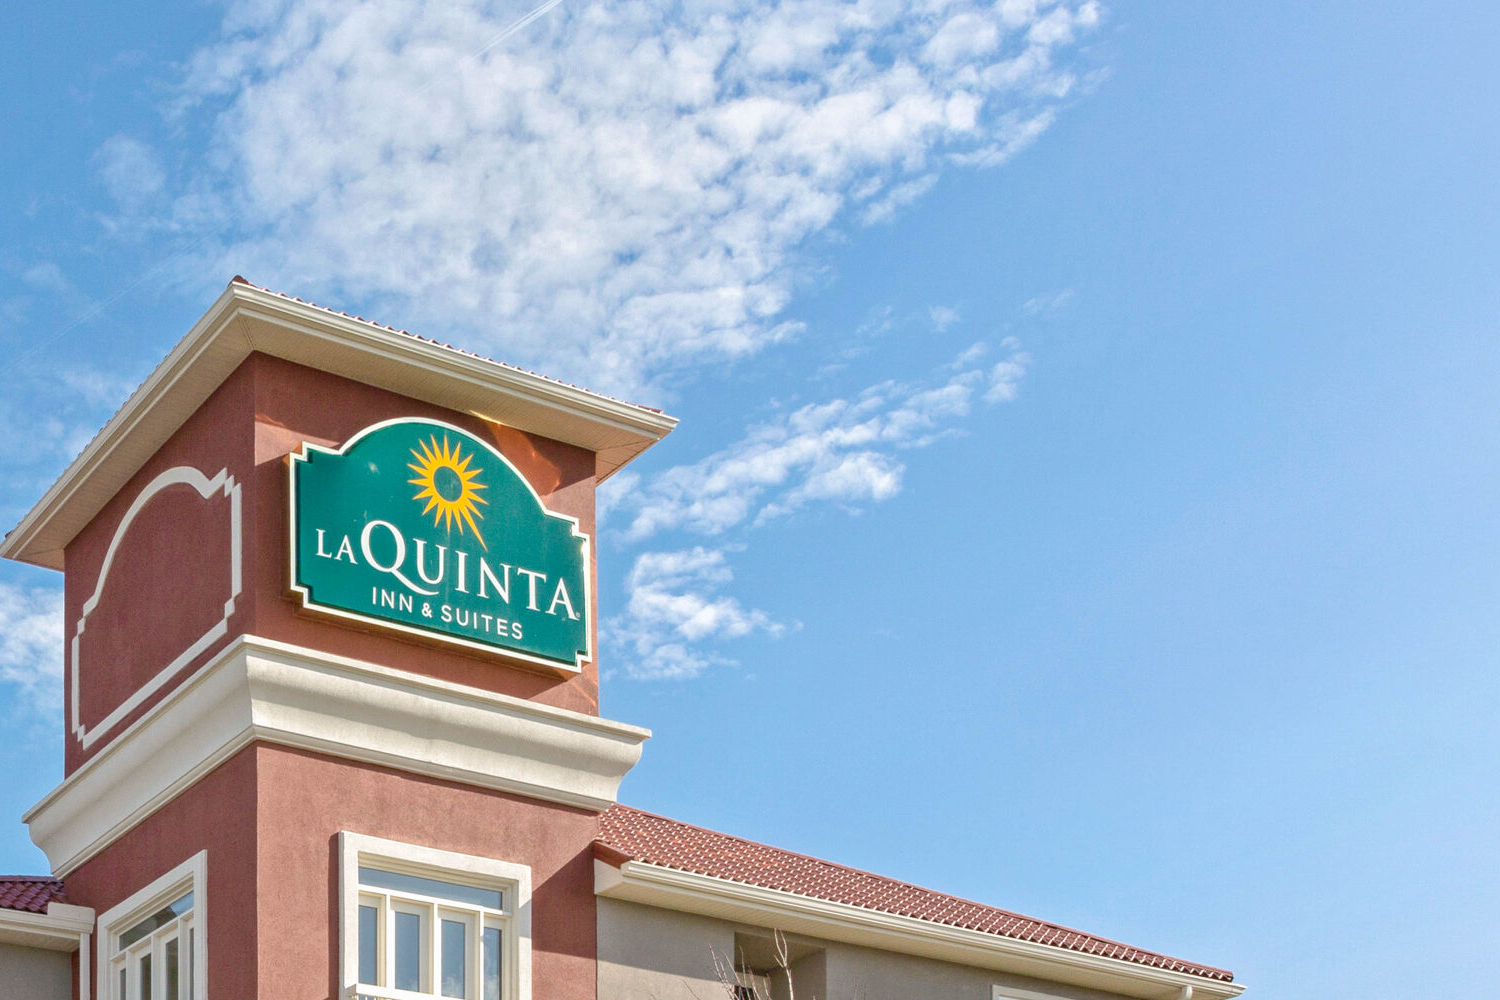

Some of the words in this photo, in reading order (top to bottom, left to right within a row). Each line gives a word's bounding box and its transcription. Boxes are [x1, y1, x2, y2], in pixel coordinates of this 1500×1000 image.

[316, 529, 358, 564] LA
[360, 520, 580, 620] QUINTA
[372, 587, 413, 613] INN
[421, 603, 433, 618] &
[441, 605, 523, 640] SUITES
